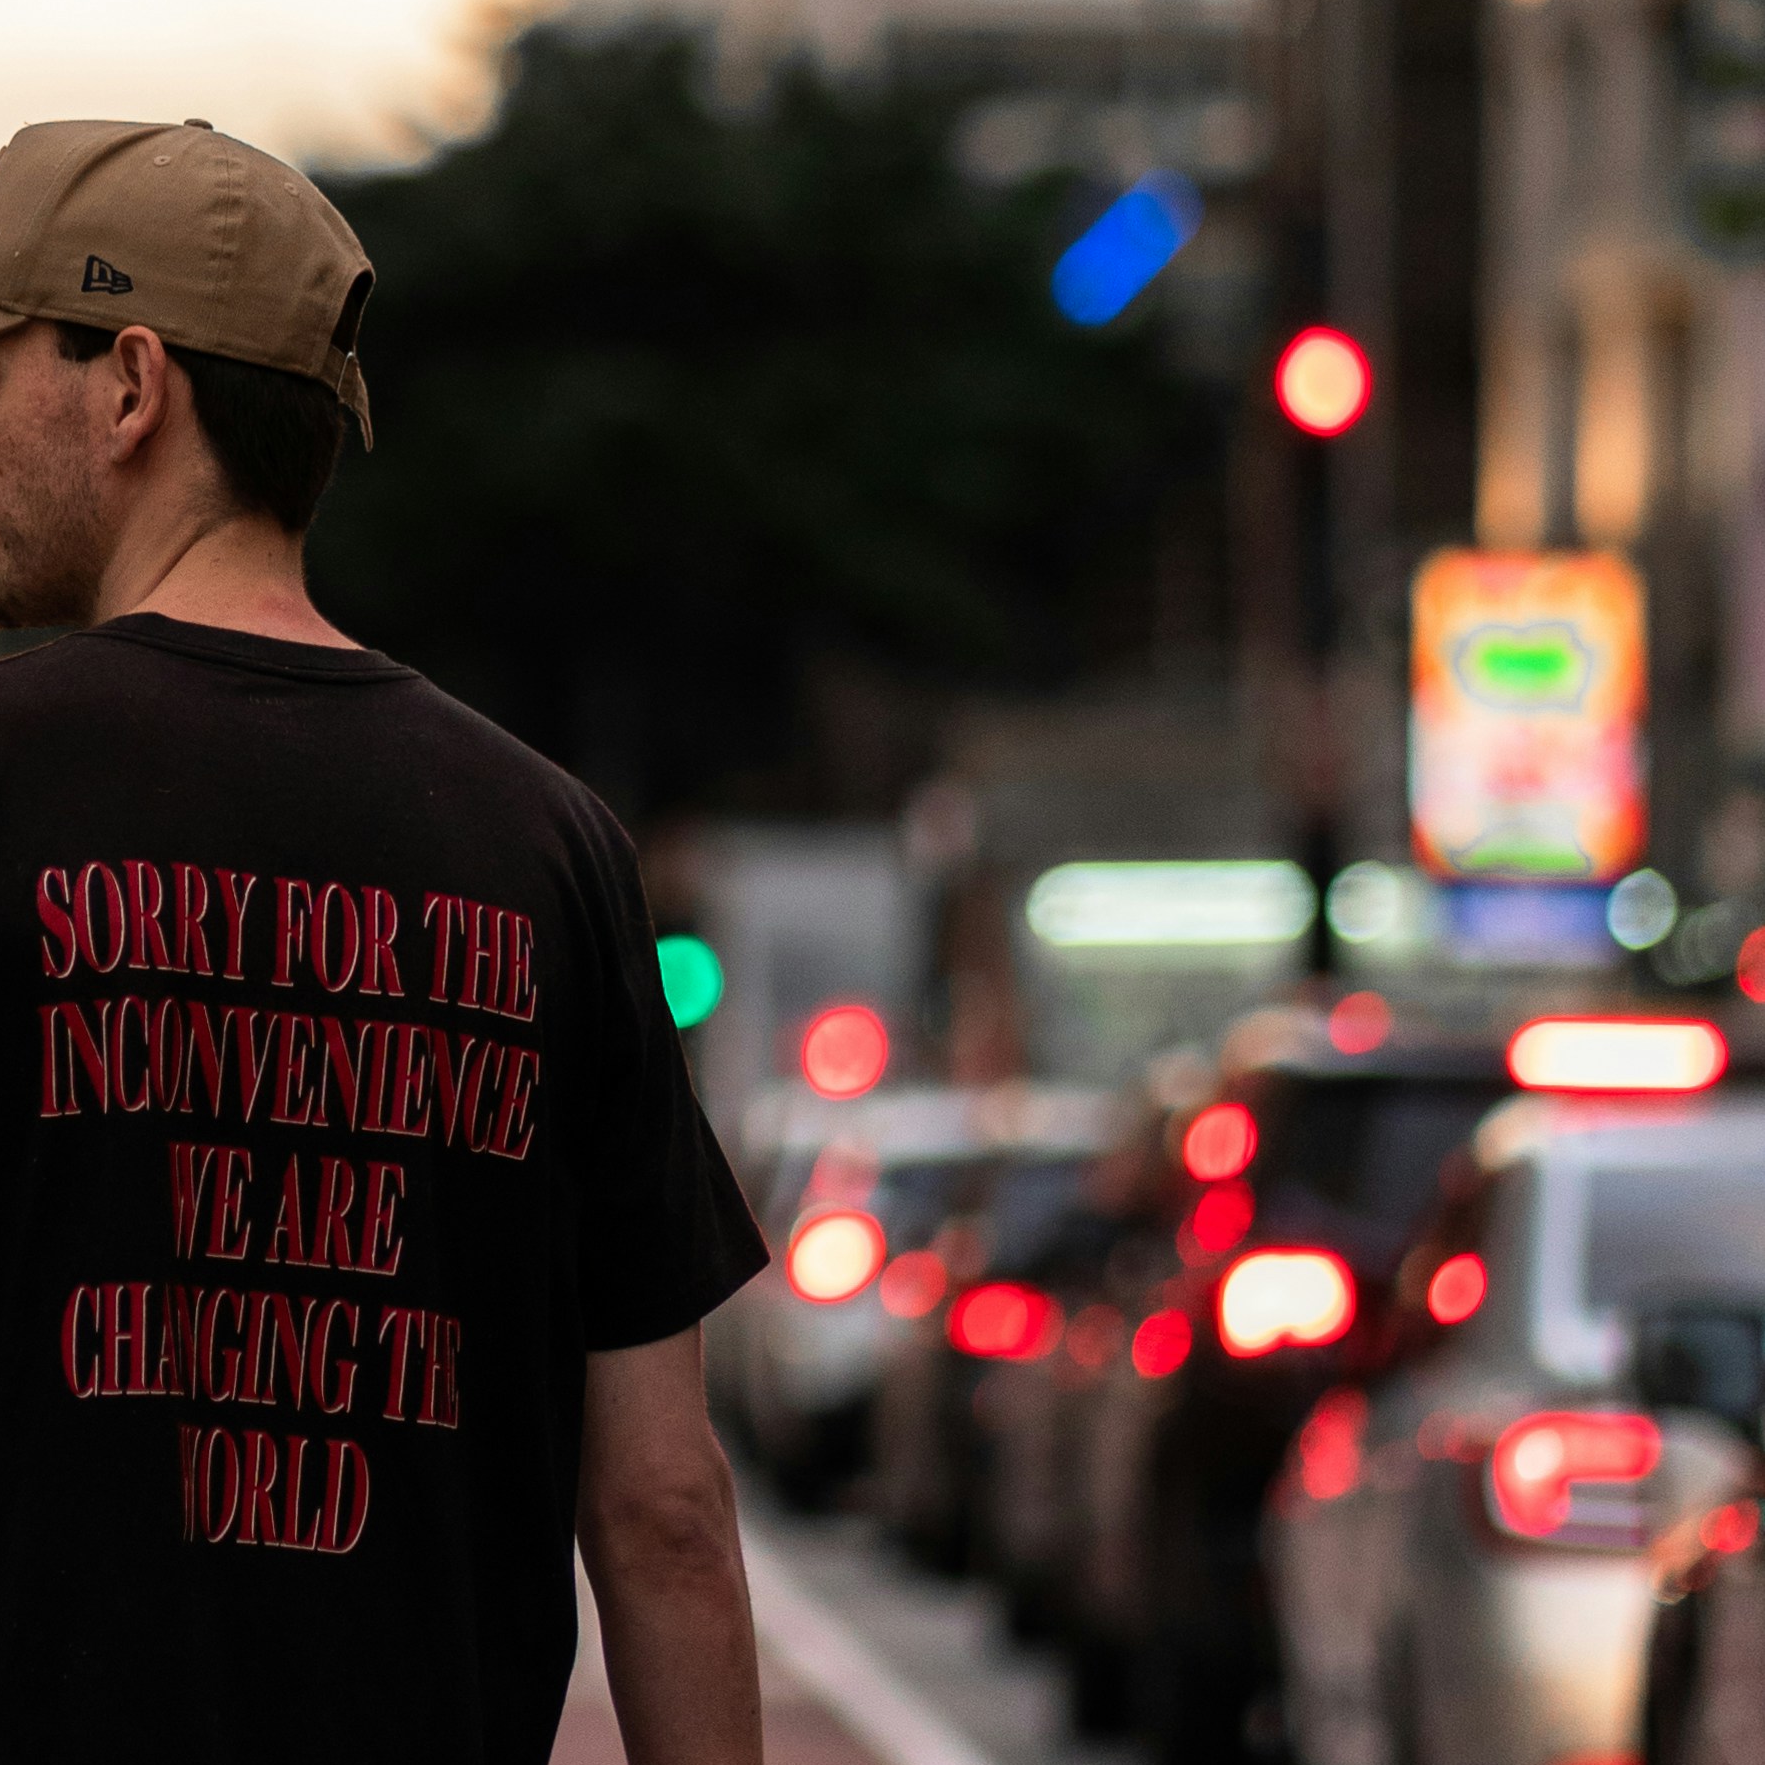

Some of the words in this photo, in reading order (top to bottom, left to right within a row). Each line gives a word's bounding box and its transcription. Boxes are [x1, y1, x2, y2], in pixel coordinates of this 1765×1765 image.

[35, 858, 258, 981] SORRY
[271, 875, 406, 998] FOR
[422, 889, 538, 1023] THE
[38, 994, 540, 1161] INCONVENIENCE
[168, 1141, 254, 1260] WE
[264, 1153, 406, 1277] ARE
[60, 1280, 361, 1414] CHANGING
